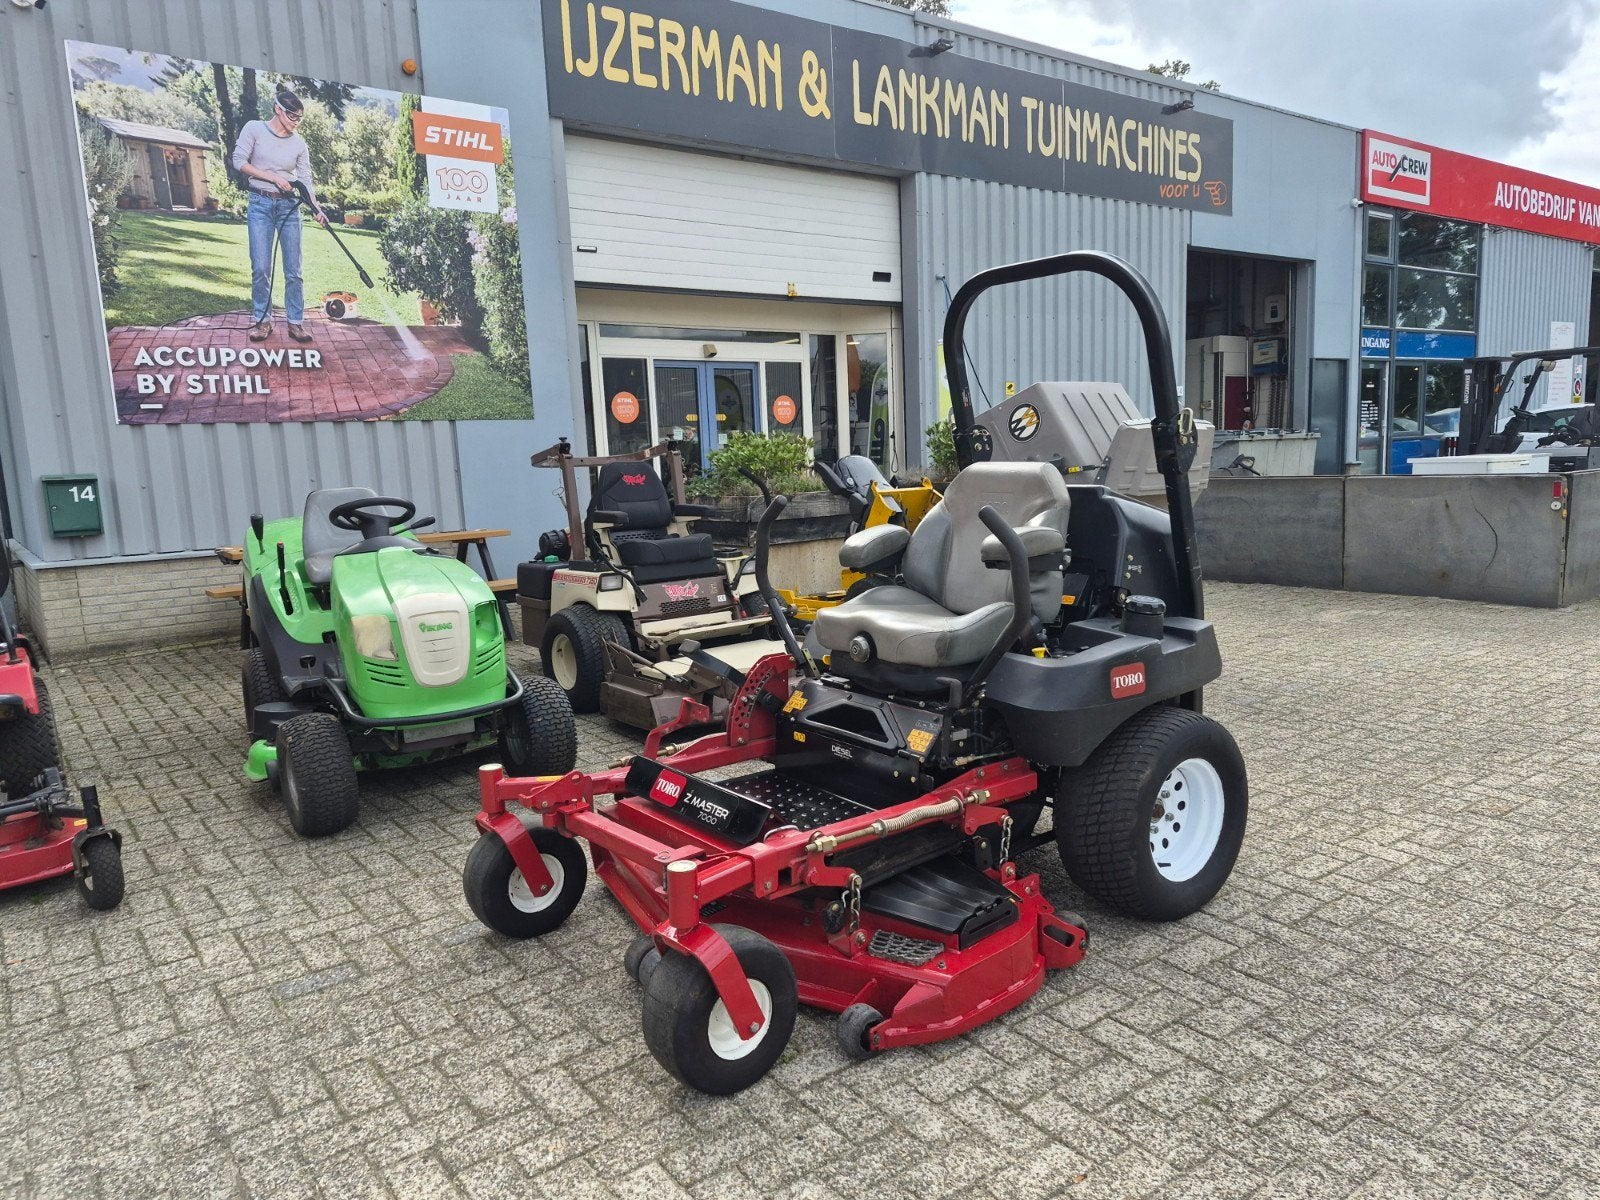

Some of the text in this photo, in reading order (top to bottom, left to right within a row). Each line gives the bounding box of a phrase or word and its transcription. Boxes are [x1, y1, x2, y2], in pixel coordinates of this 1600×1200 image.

[560, 0, 1202, 183] IJZERMAN & LANKMAN TUINMACHINES
[424, 125, 494, 151] STIHL
[436, 166, 488, 194] 100
[446, 193, 482, 203] JAAR
[1494, 181, 1600, 228] AUTOBEDRIJF VAN
[133, 346, 322, 368] ACCUPOWER
[136, 374, 271, 395] BY STIHL
[68, 485, 96, 503] 14
[418, 622, 453, 633] VIKING
[1113, 672, 1144, 689] TORO
[656, 778, 681, 798] TORO
[683, 792, 730, 820] Z MASTER
[697, 811, 718, 825] 7000
